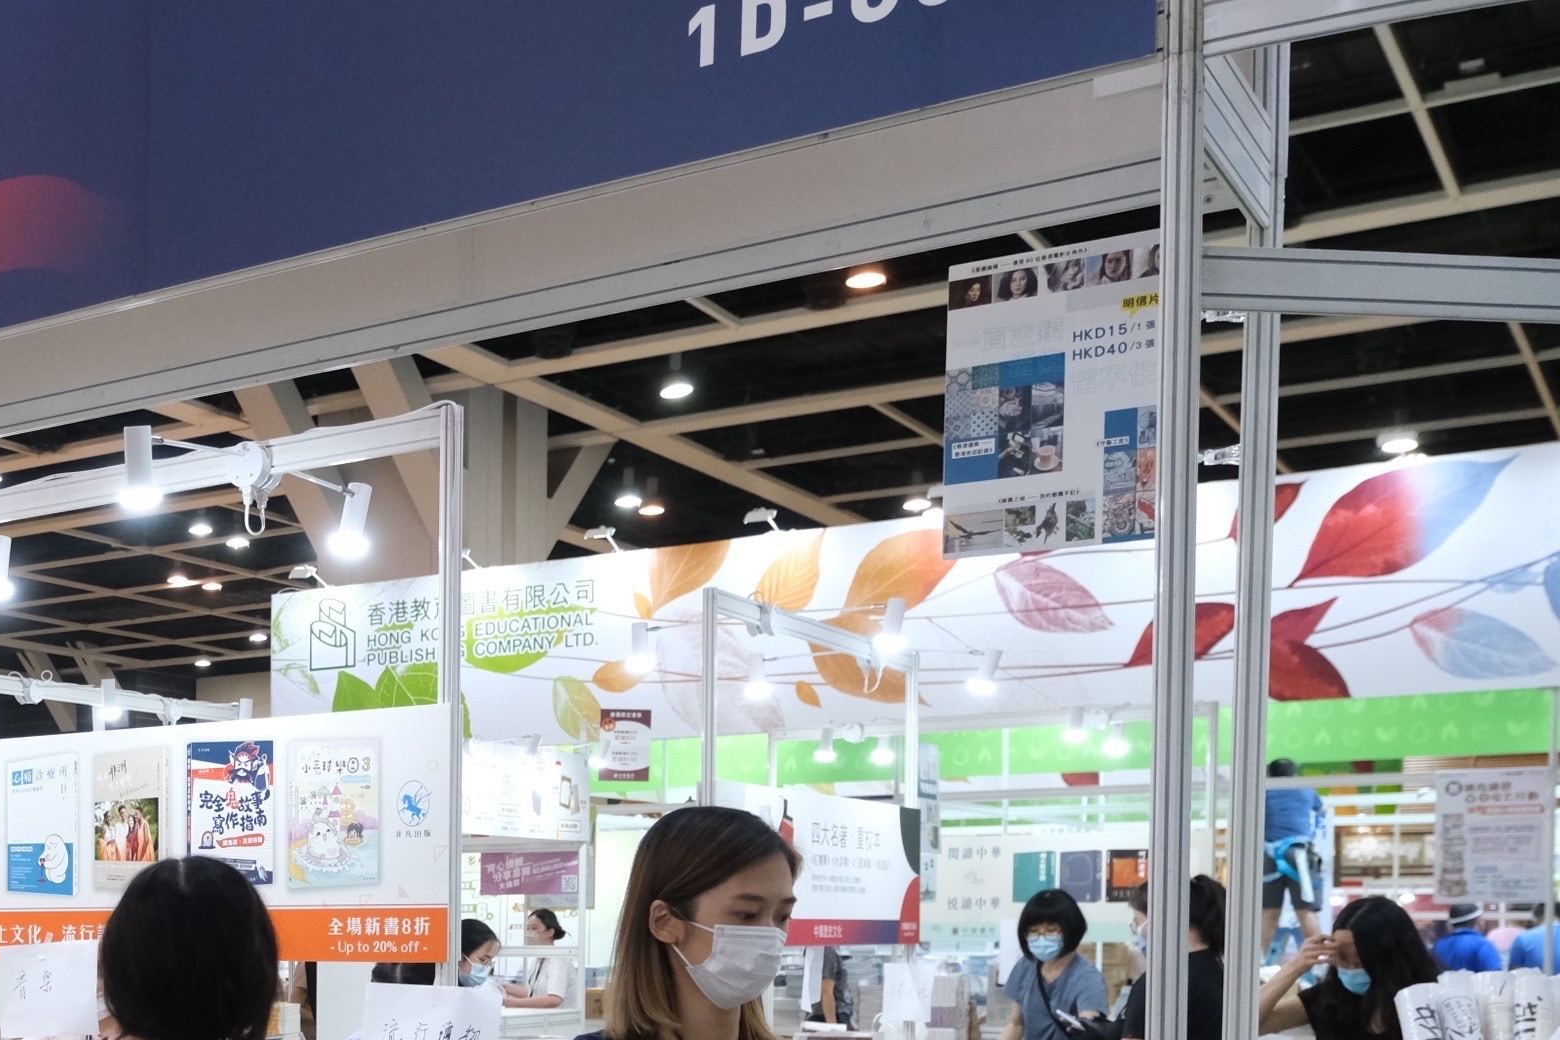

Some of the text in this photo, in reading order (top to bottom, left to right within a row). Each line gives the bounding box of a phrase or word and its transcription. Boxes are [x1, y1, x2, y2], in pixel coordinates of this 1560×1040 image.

[367, 630, 412, 654] HONG
[475, 609, 594, 638] EDUCATIONAL
[475, 636, 555, 657] COMPANY
[564, 631, 599, 649] LTD.
[811, 822, 848, 849] 四大名著
[328, 917, 431, 937] 全場新書8折
[338, 940, 420, 955] Up to 20% off
